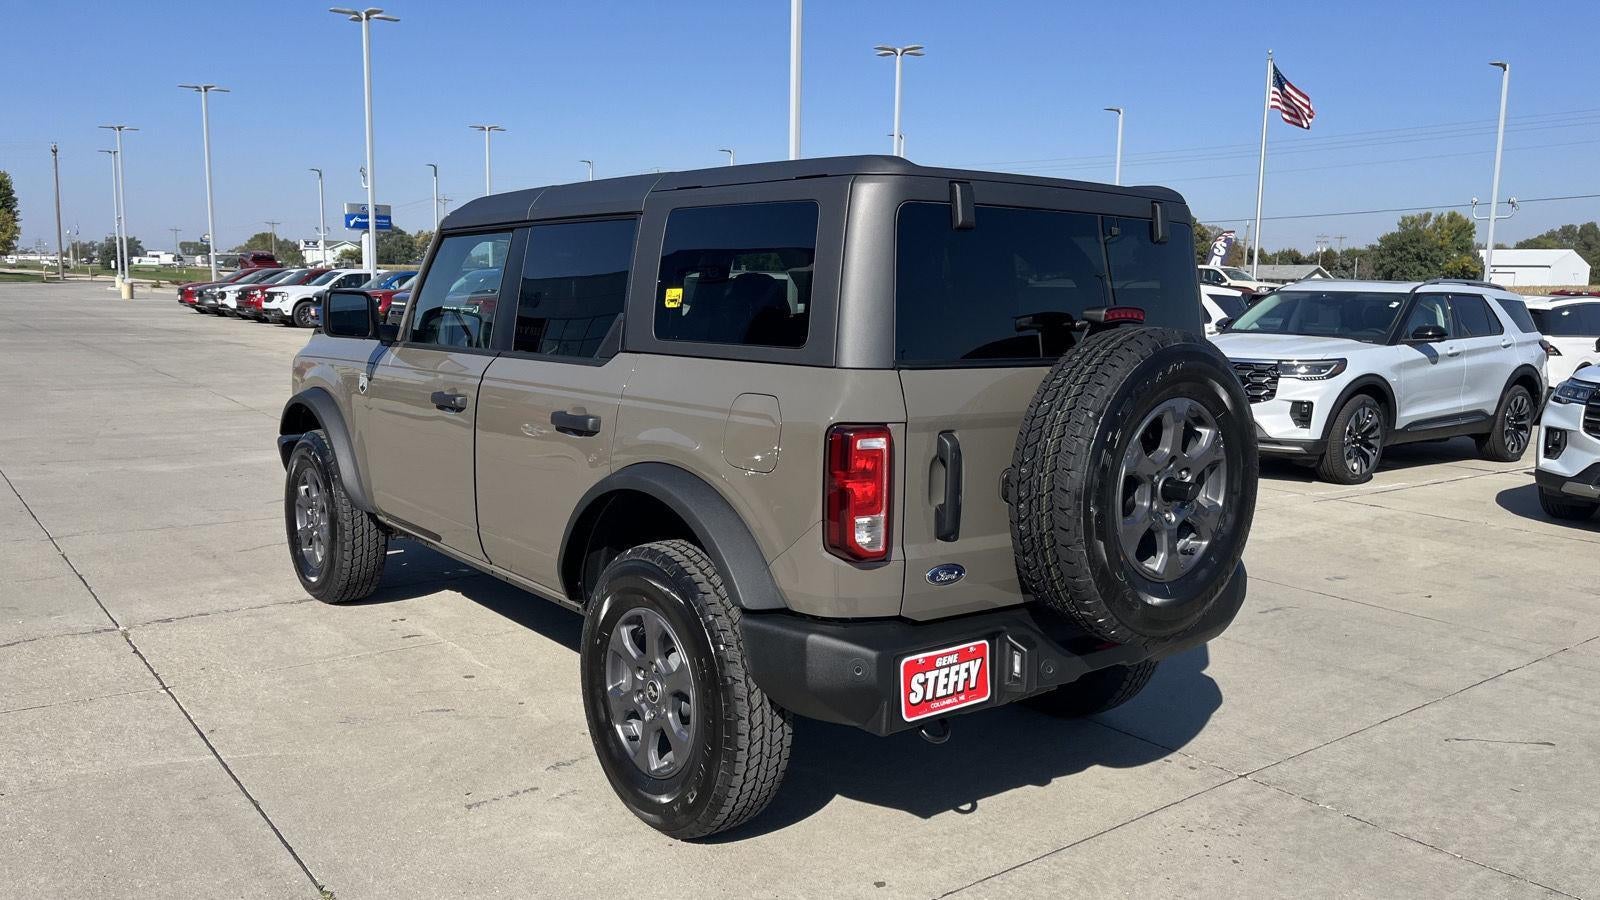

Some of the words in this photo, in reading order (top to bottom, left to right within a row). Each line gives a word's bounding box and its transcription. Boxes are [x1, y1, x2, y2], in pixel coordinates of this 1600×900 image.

[936, 570, 958, 581] Ford
[935, 653, 959, 668] GENE
[909, 658, 982, 705] STEFFY
